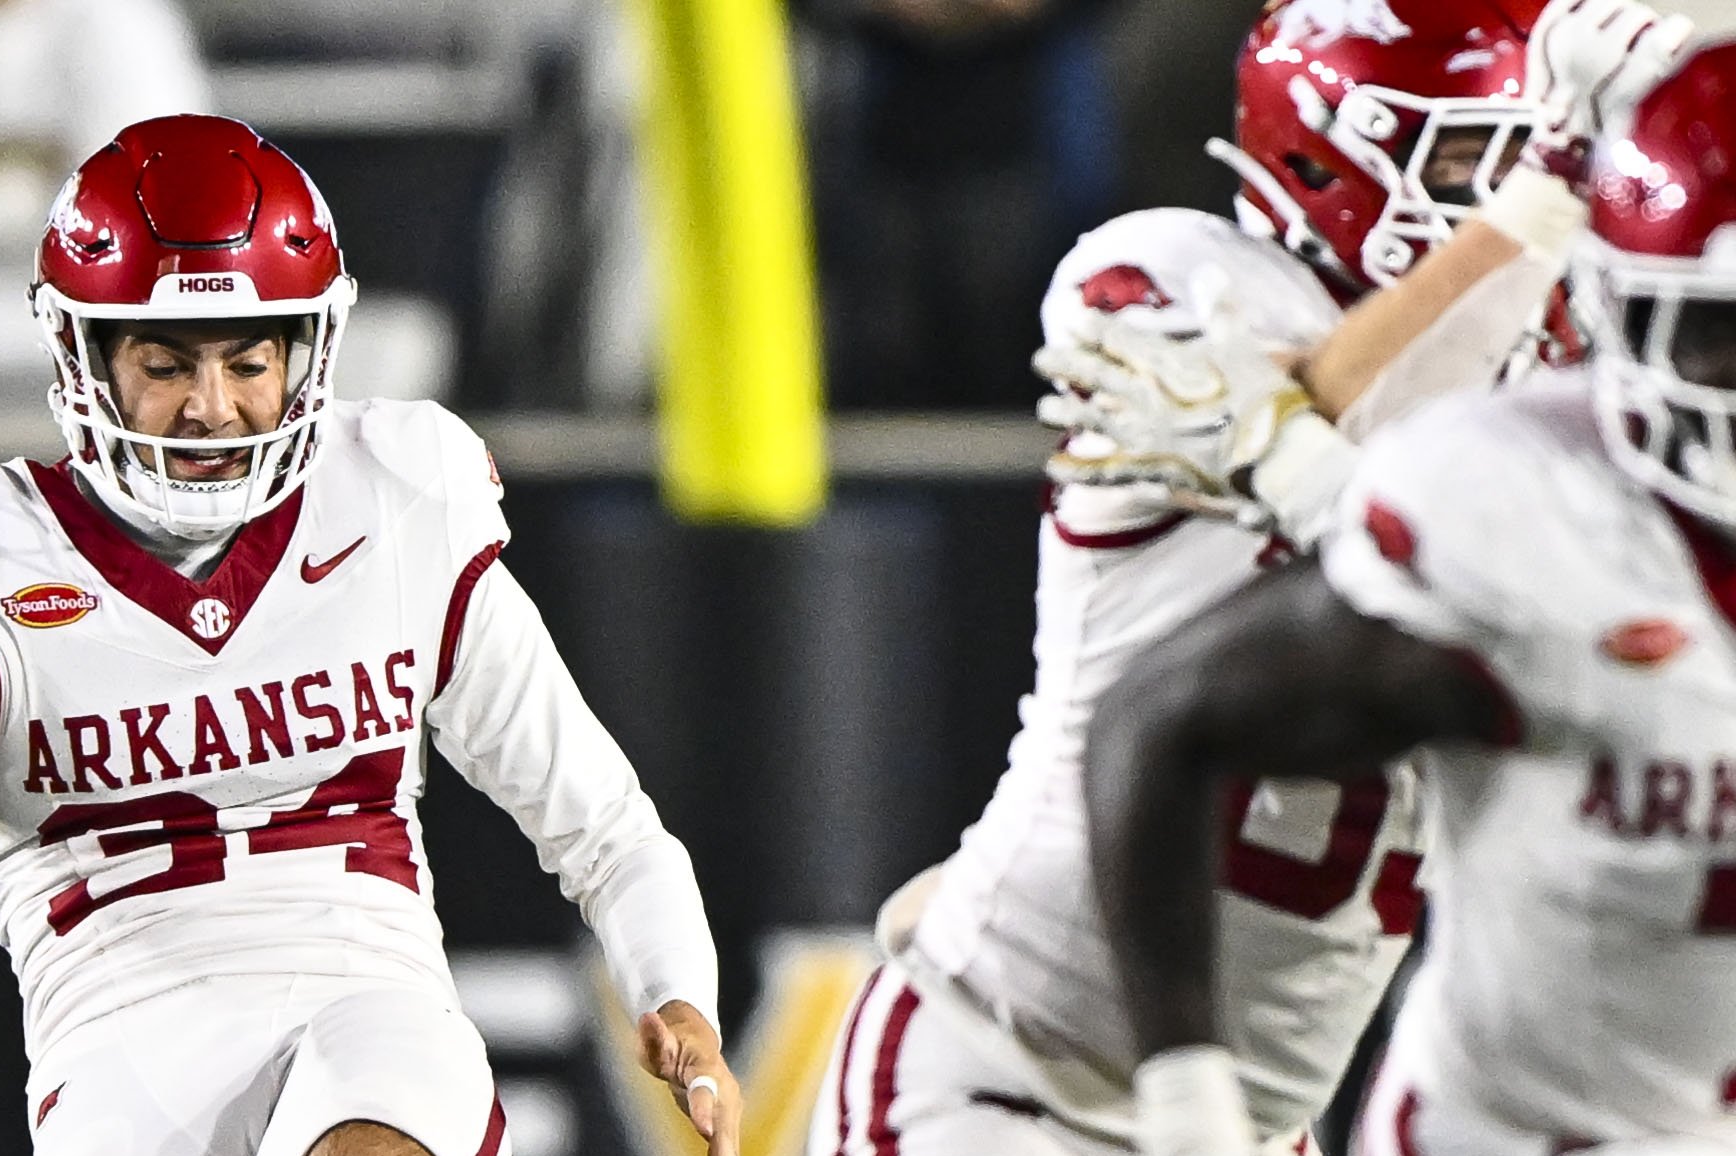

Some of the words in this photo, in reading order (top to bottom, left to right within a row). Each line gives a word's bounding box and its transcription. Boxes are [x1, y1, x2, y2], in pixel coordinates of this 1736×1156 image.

[178, 276, 235, 294] HOGS
[189, 598, 231, 638] SEC
[23, 649, 416, 794] ARKANSAS
[36, 744, 421, 937] 34
